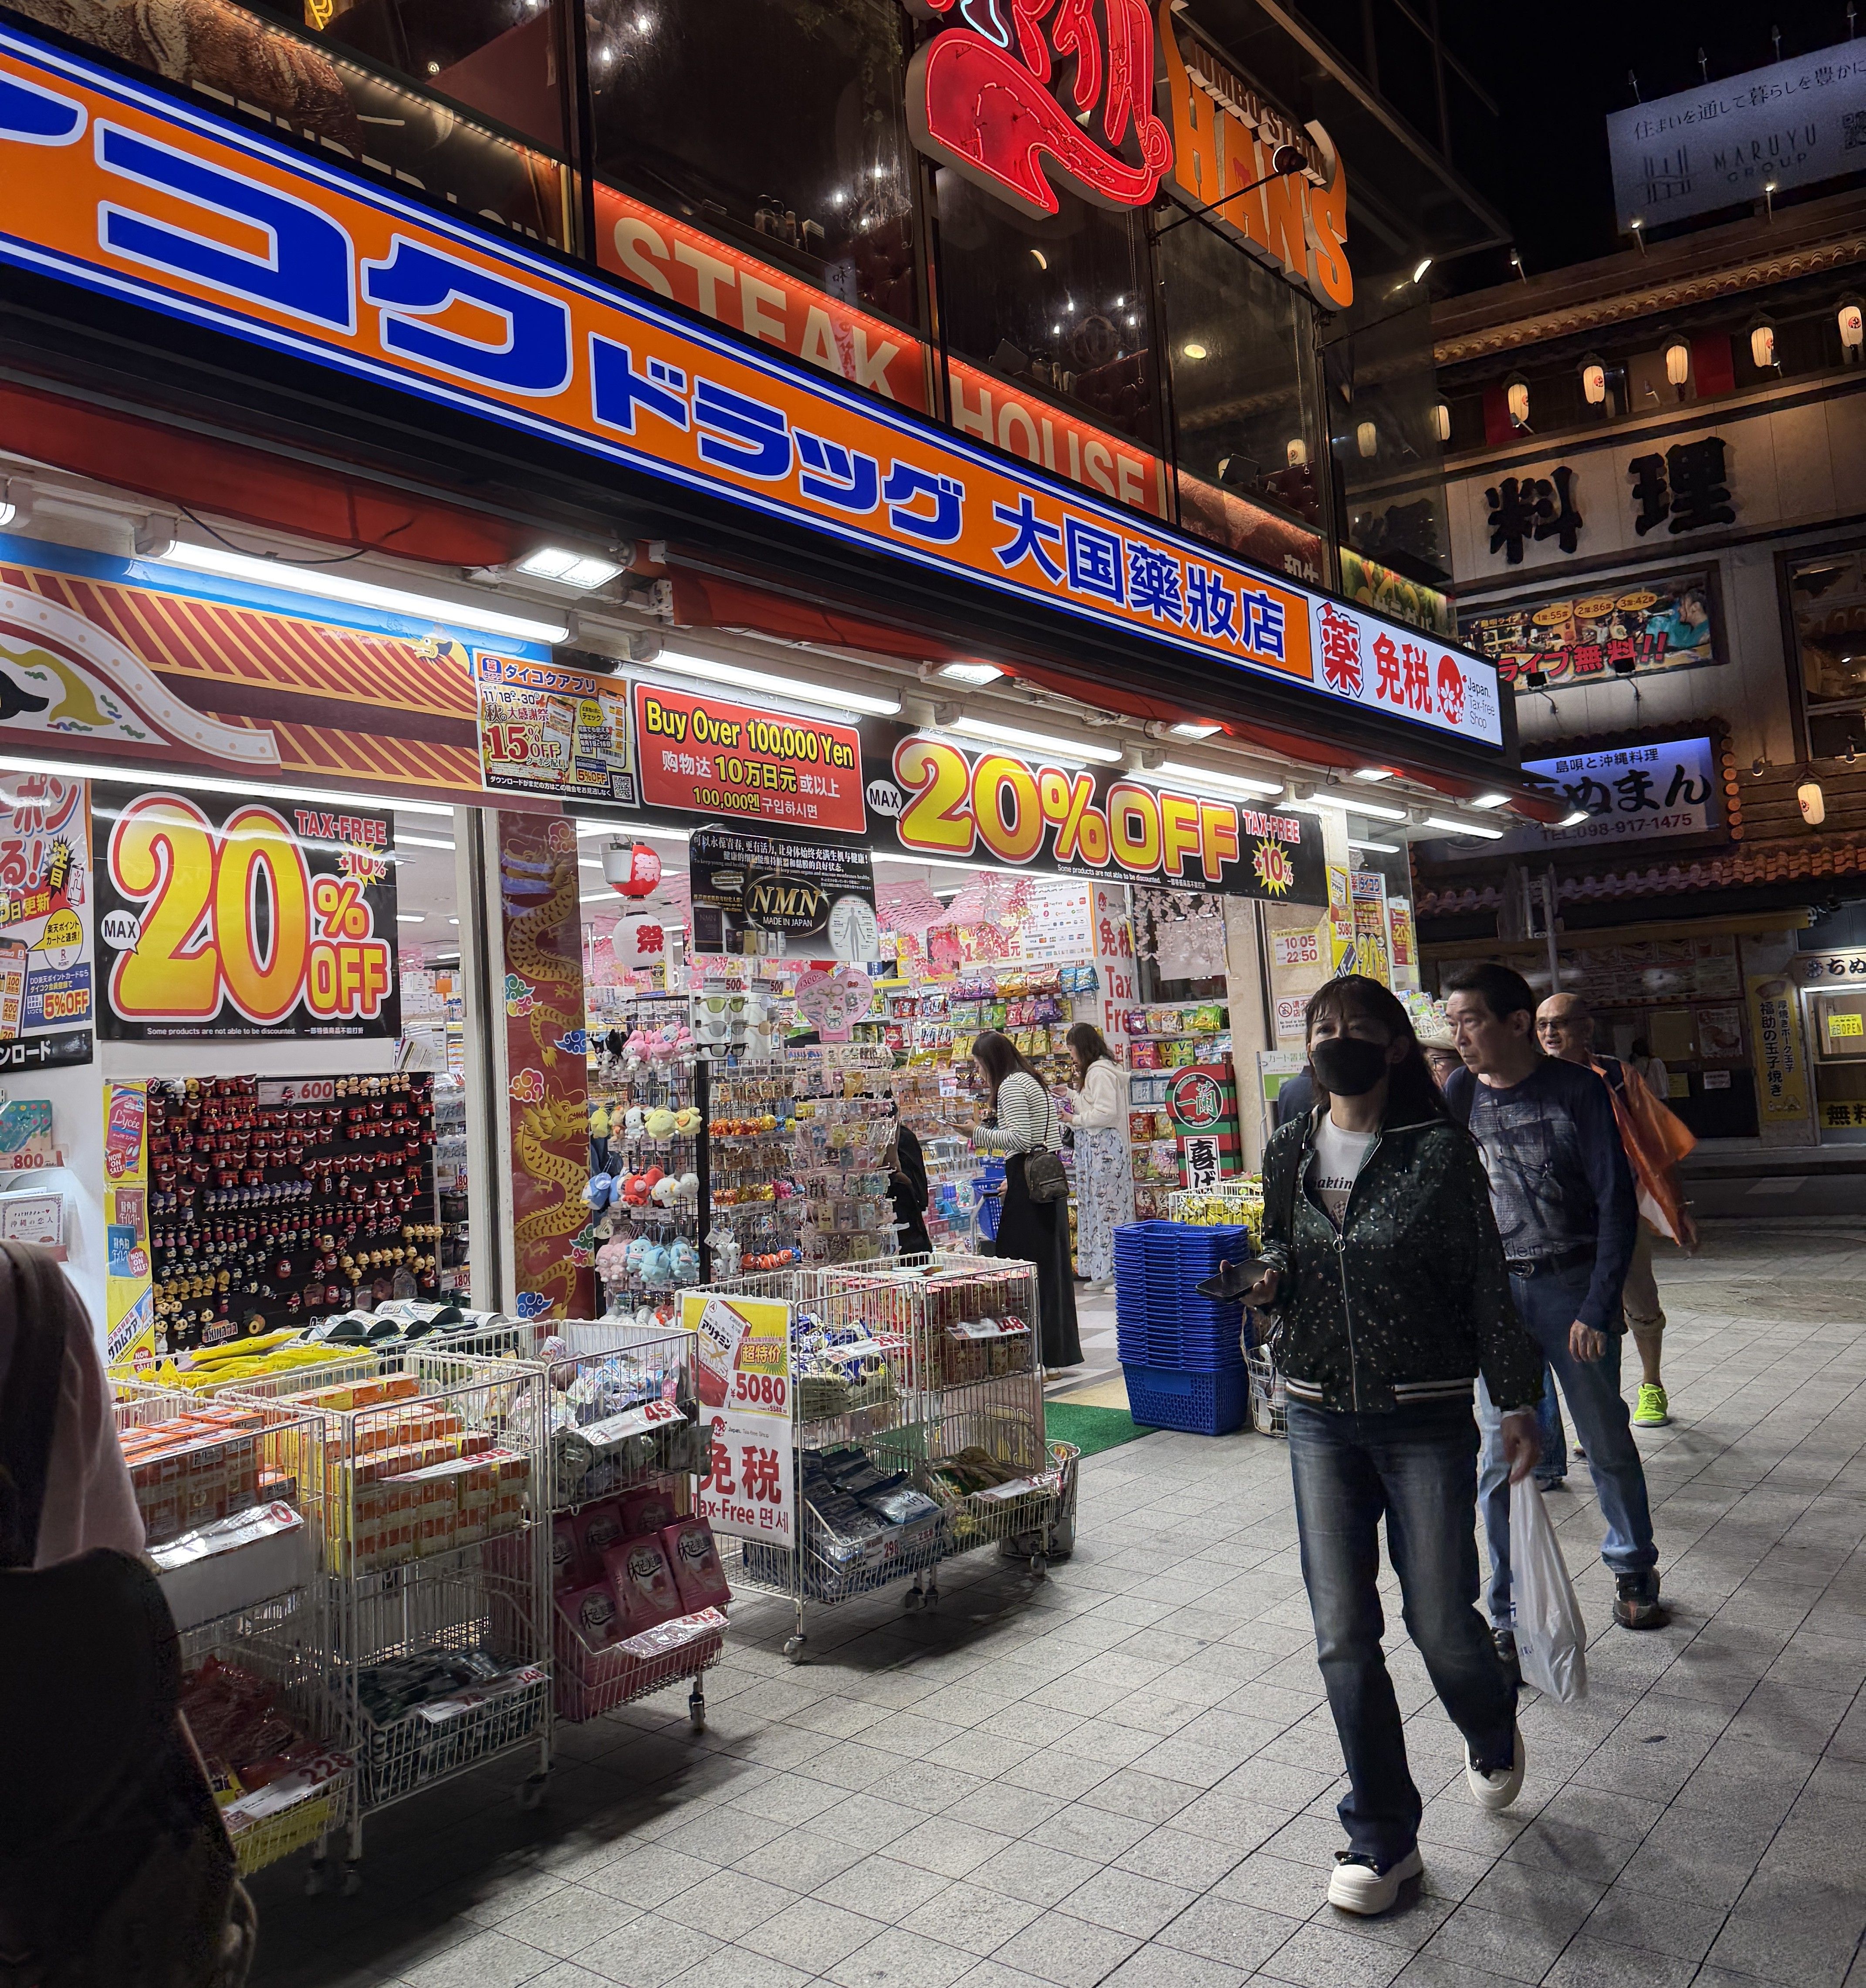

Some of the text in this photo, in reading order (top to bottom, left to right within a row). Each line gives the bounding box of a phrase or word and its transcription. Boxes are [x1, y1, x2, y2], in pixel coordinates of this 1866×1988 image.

[1714, 123, 1816, 172] MARUYU
[1727, 153, 1806, 182] GROUP
[0, 70, 965, 544] コクドラッグ
[992, 493, 1286, 663] 大国藥妝店
[614, 217, 1144, 505] STEAK HOUSE
[1484, 435, 1736, 565] 料理
[1316, 602, 1364, 698] 薬
[505, 665, 596, 693] ダイコクアプリ
[1372, 632, 1433, 714] 免税
[1468, 677, 1491, 698] Japan.
[485, 702, 549, 722] 秋の大感謝祭
[1468, 695, 1495, 716] Tax-free
[1470, 712, 1487, 730] Shop
[647, 700, 687, 741] Buy
[693, 710, 740, 746] Over
[748, 721, 818, 760] 100,000
[820, 734, 854, 767] Yen
[578, 769, 607, 785] 5%OFF
[662, 750, 841, 797] 购物达 10万日元 或以上
[693, 787, 818, 819] 100,000엔 구입하시면
[870, 788, 899, 810] MAX
[294, 809, 388, 845] TAX-FREE
[1242, 810, 1301, 844] TAX-FREE
[339, 851, 386, 877] +10%
[1058, 864, 1072, 873] Some
[1072, 867, 1094, 876] products
[1254, 844, 1294, 886] +10%
[750, 885, 819, 917] NMN
[105, 919, 136, 939] MAX
[763, 916, 813, 927] MADE IN JAPAN
[636, 925, 664, 954] 祭
[7, 976, 20, 986] 100
[726, 979, 741, 991] 500
[1105, 965, 1132, 999] Tax
[4, 1003, 17, 1014] 200
[44, 989, 89, 1018] 5%OFF
[169, 1027, 200, 1036] products
[261, 1027, 297, 1035] discounted.
[1759, 1001, 1783, 1097] 福助の玉子焼き
[301, 1082, 333, 1099] 600
[14, 1153, 44, 1168] 800
[108, 1153, 122, 1162] NOW
[110, 1164, 125, 1175] SALE!
[131, 1251, 144, 1260] NOW
[132, 1262, 148, 1273] SALE!
[701, 1319, 733, 1350] アリナミン
[994, 1317, 1025, 1333] 148
[134, 1350, 149, 1359] NOW
[741, 1343, 782, 1364] 超特价
[462, 1448, 513, 1465] 598
[700, 1440, 782, 1505] 免税
[759, 1507, 789, 1534] 면세
